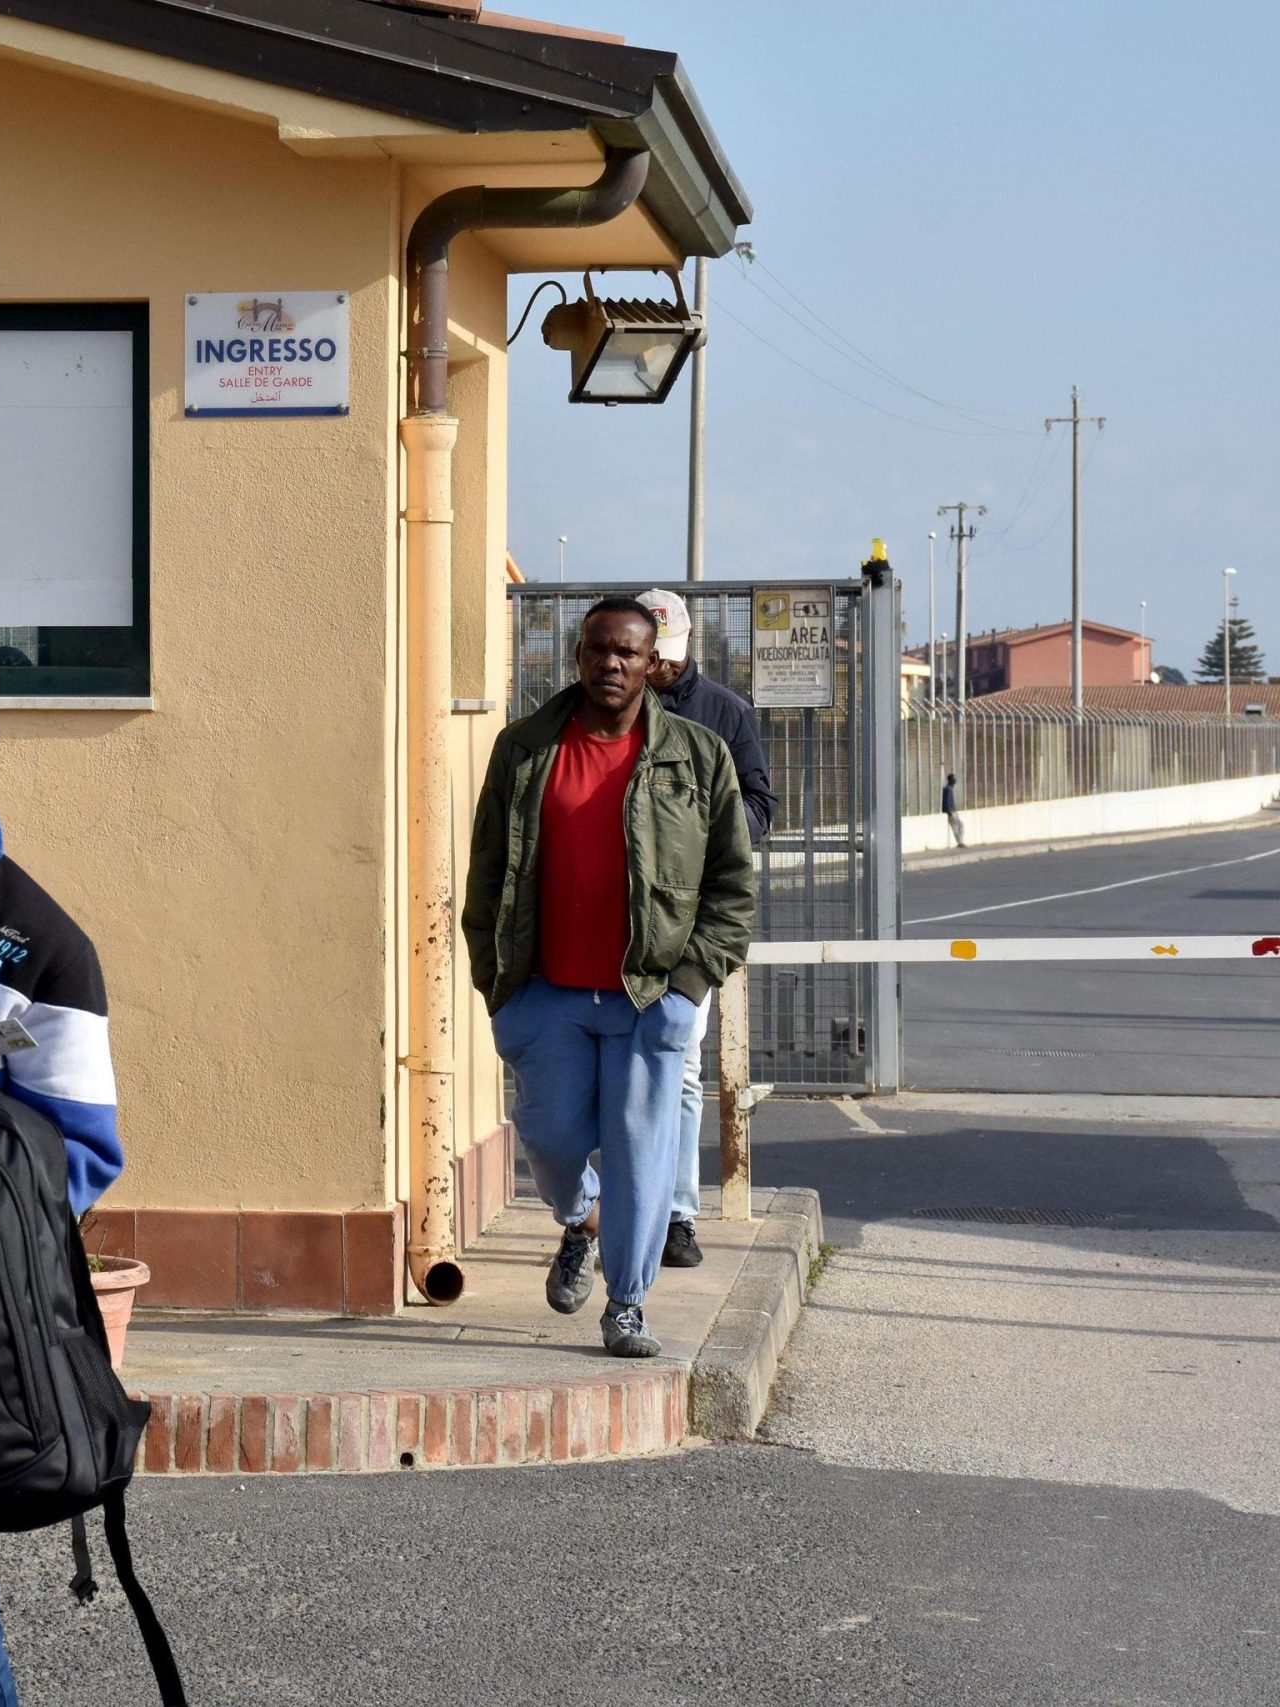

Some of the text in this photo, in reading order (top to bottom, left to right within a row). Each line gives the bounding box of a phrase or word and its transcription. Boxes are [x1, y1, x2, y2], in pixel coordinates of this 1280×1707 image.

[196, 337, 337, 364] INGRESSO
[248, 366, 283, 376] ENTRY
[219, 377, 313, 388] SALLE DE GARDE
[790, 627, 829, 644] AREA
[756, 646, 830, 661] VIDEOSORVEGLIATA
